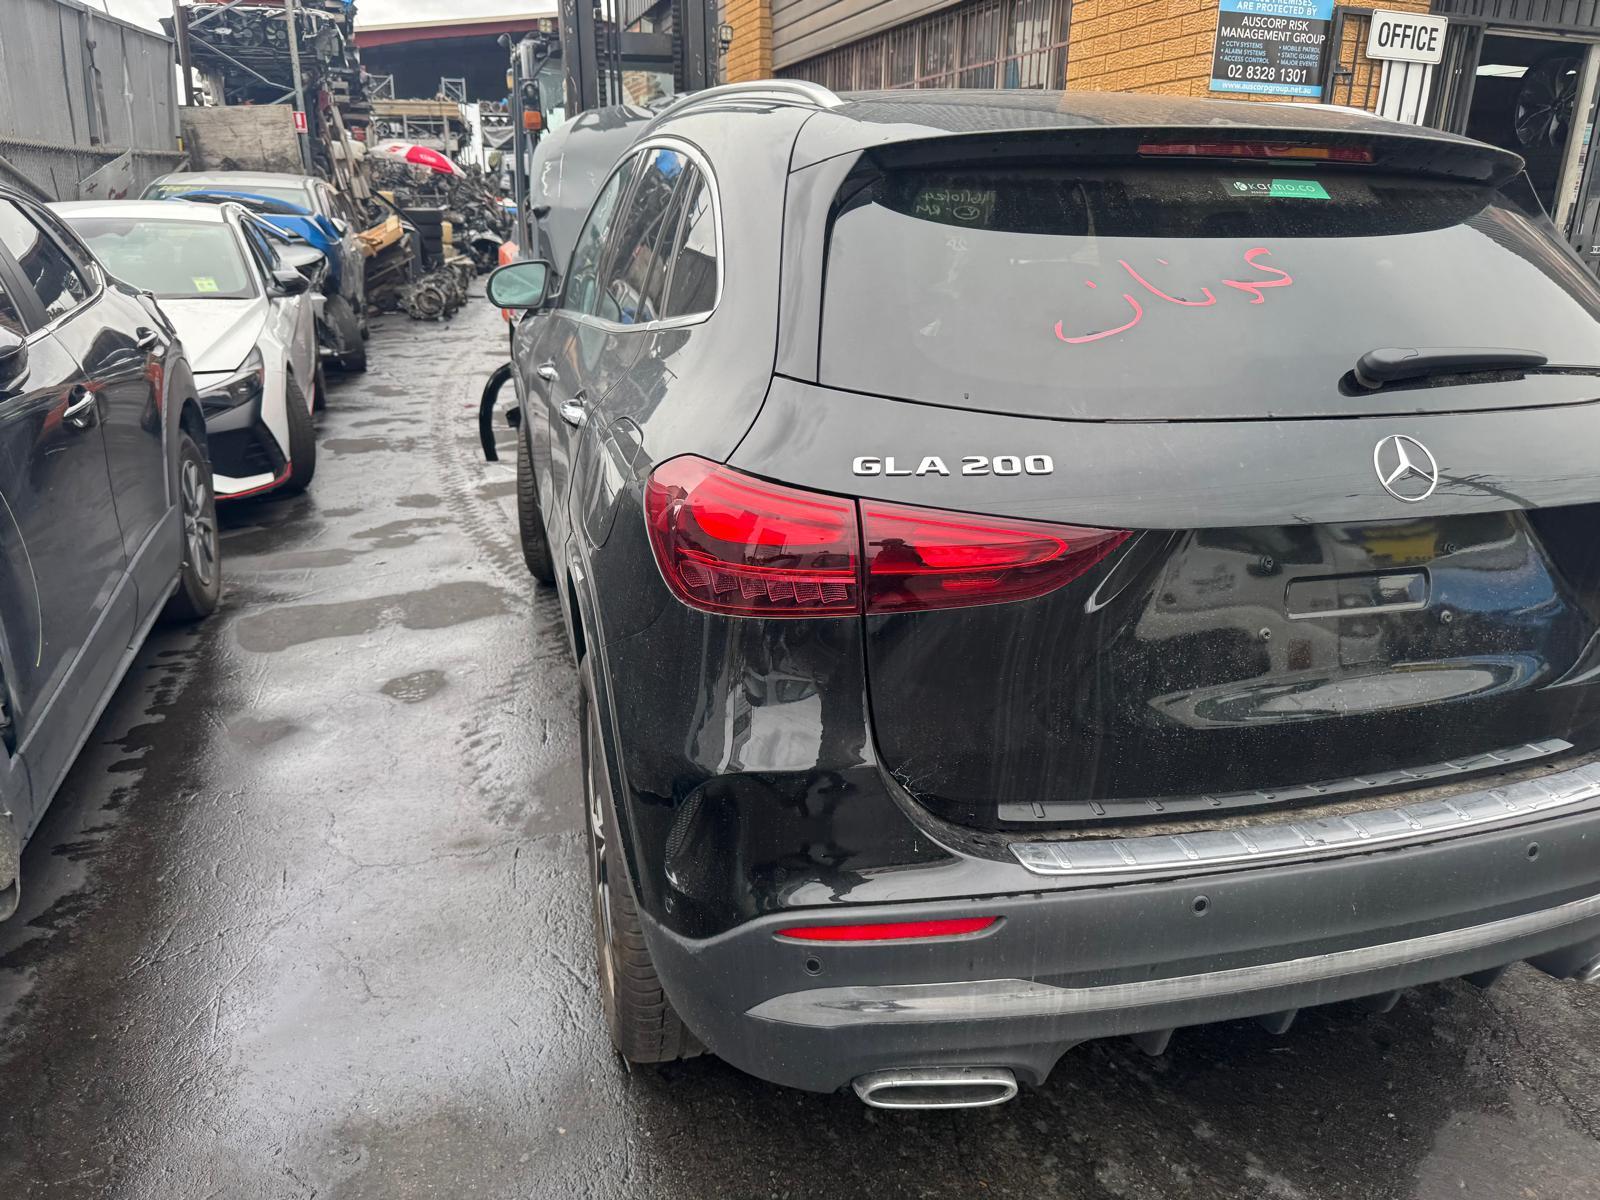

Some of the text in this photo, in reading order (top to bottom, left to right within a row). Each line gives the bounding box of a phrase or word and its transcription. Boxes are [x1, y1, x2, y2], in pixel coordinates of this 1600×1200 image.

[1237, 2, 1317, 16] ARE PROTECTED BY
[1242, 16, 1309, 31] AUSCORP RISK
[1221, 26, 1325, 44] MANAGEMENT GROUP
[1378, 22, 1438, 51] OFFICE
[1225, 40, 1263, 49] CCTV SYSTEMS
[1224, 47, 1266, 57] ALARM SYSTEMS
[1223, 55, 1269, 64] ACCESS CONTROL
[1228, 64, 1307, 83] 02 8328 1301
[1222, 82, 1312, 94] www.auscorpgroup.net.au
[852, 455, 1054, 476] GLA 200
